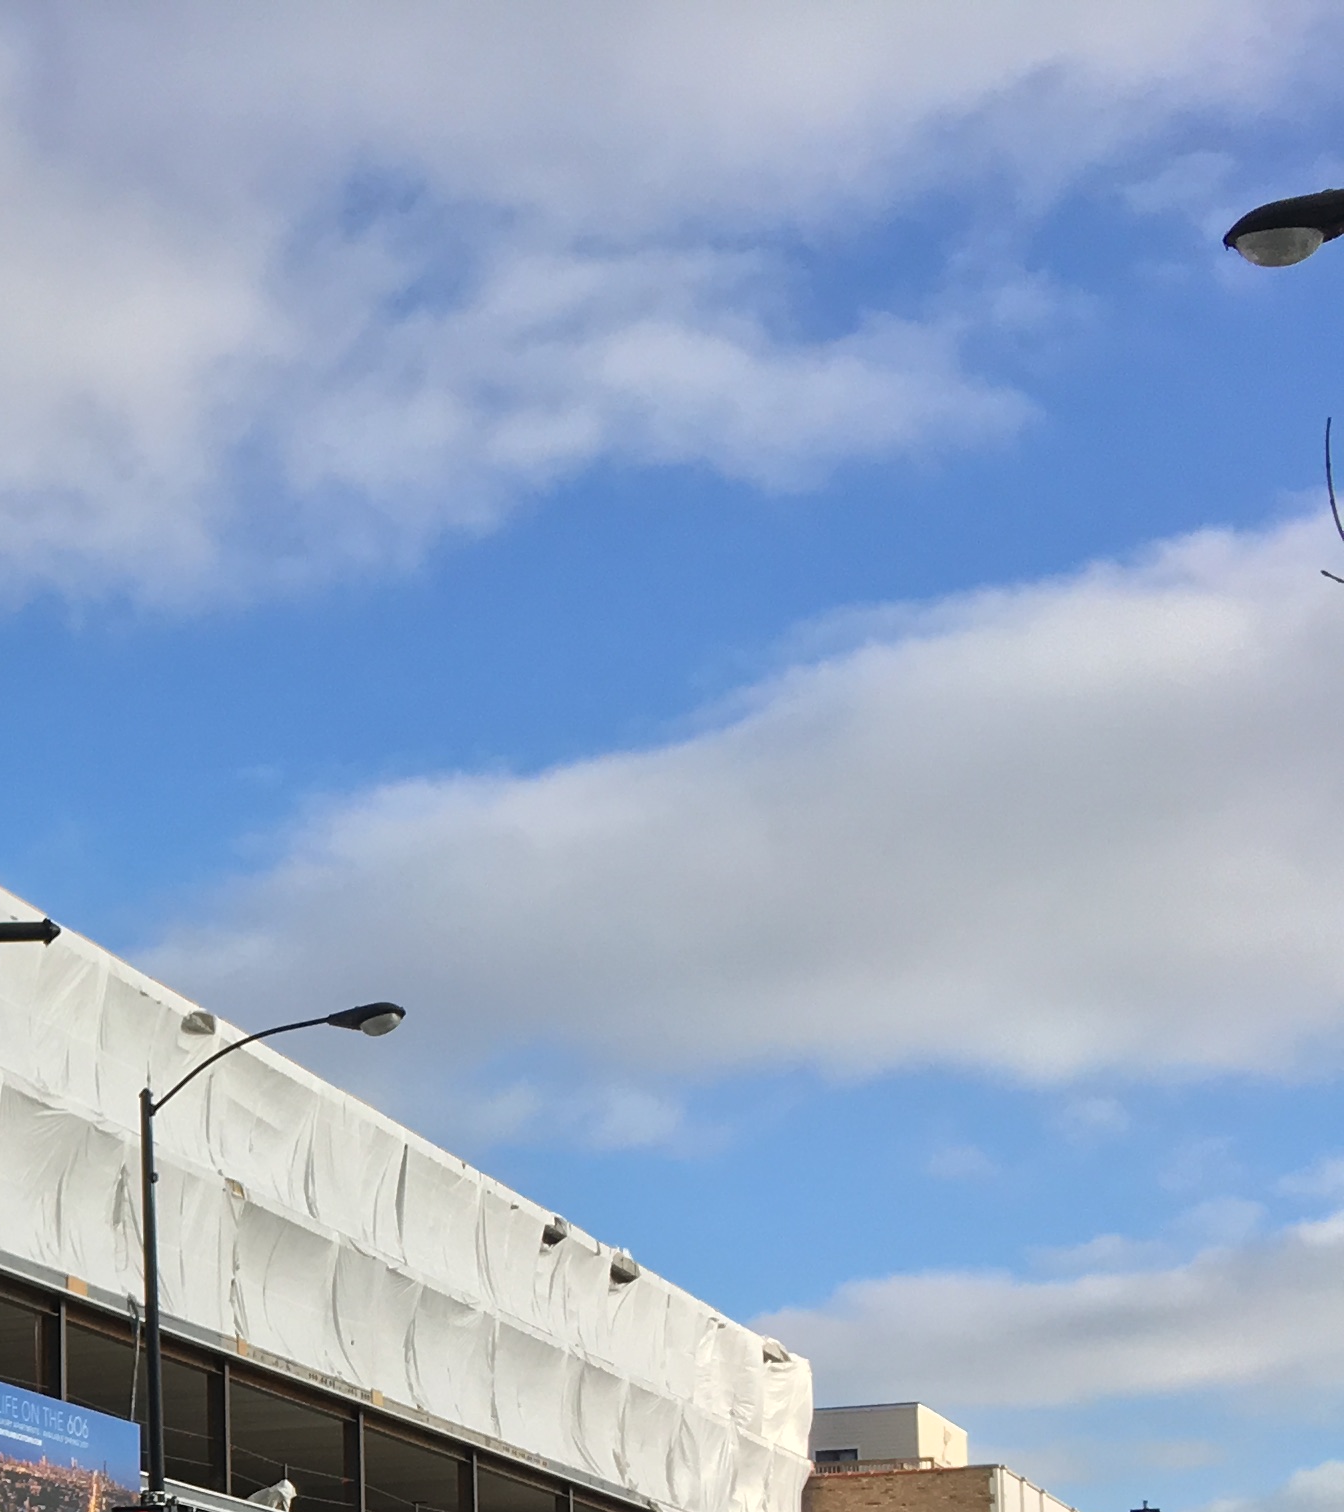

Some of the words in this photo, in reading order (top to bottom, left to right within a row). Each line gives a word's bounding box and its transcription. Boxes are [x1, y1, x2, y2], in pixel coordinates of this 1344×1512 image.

[21, 1400, 40, 1424] ON
[43, 1406, 64, 1431] THE
[66, 1415, 89, 1439] 606
